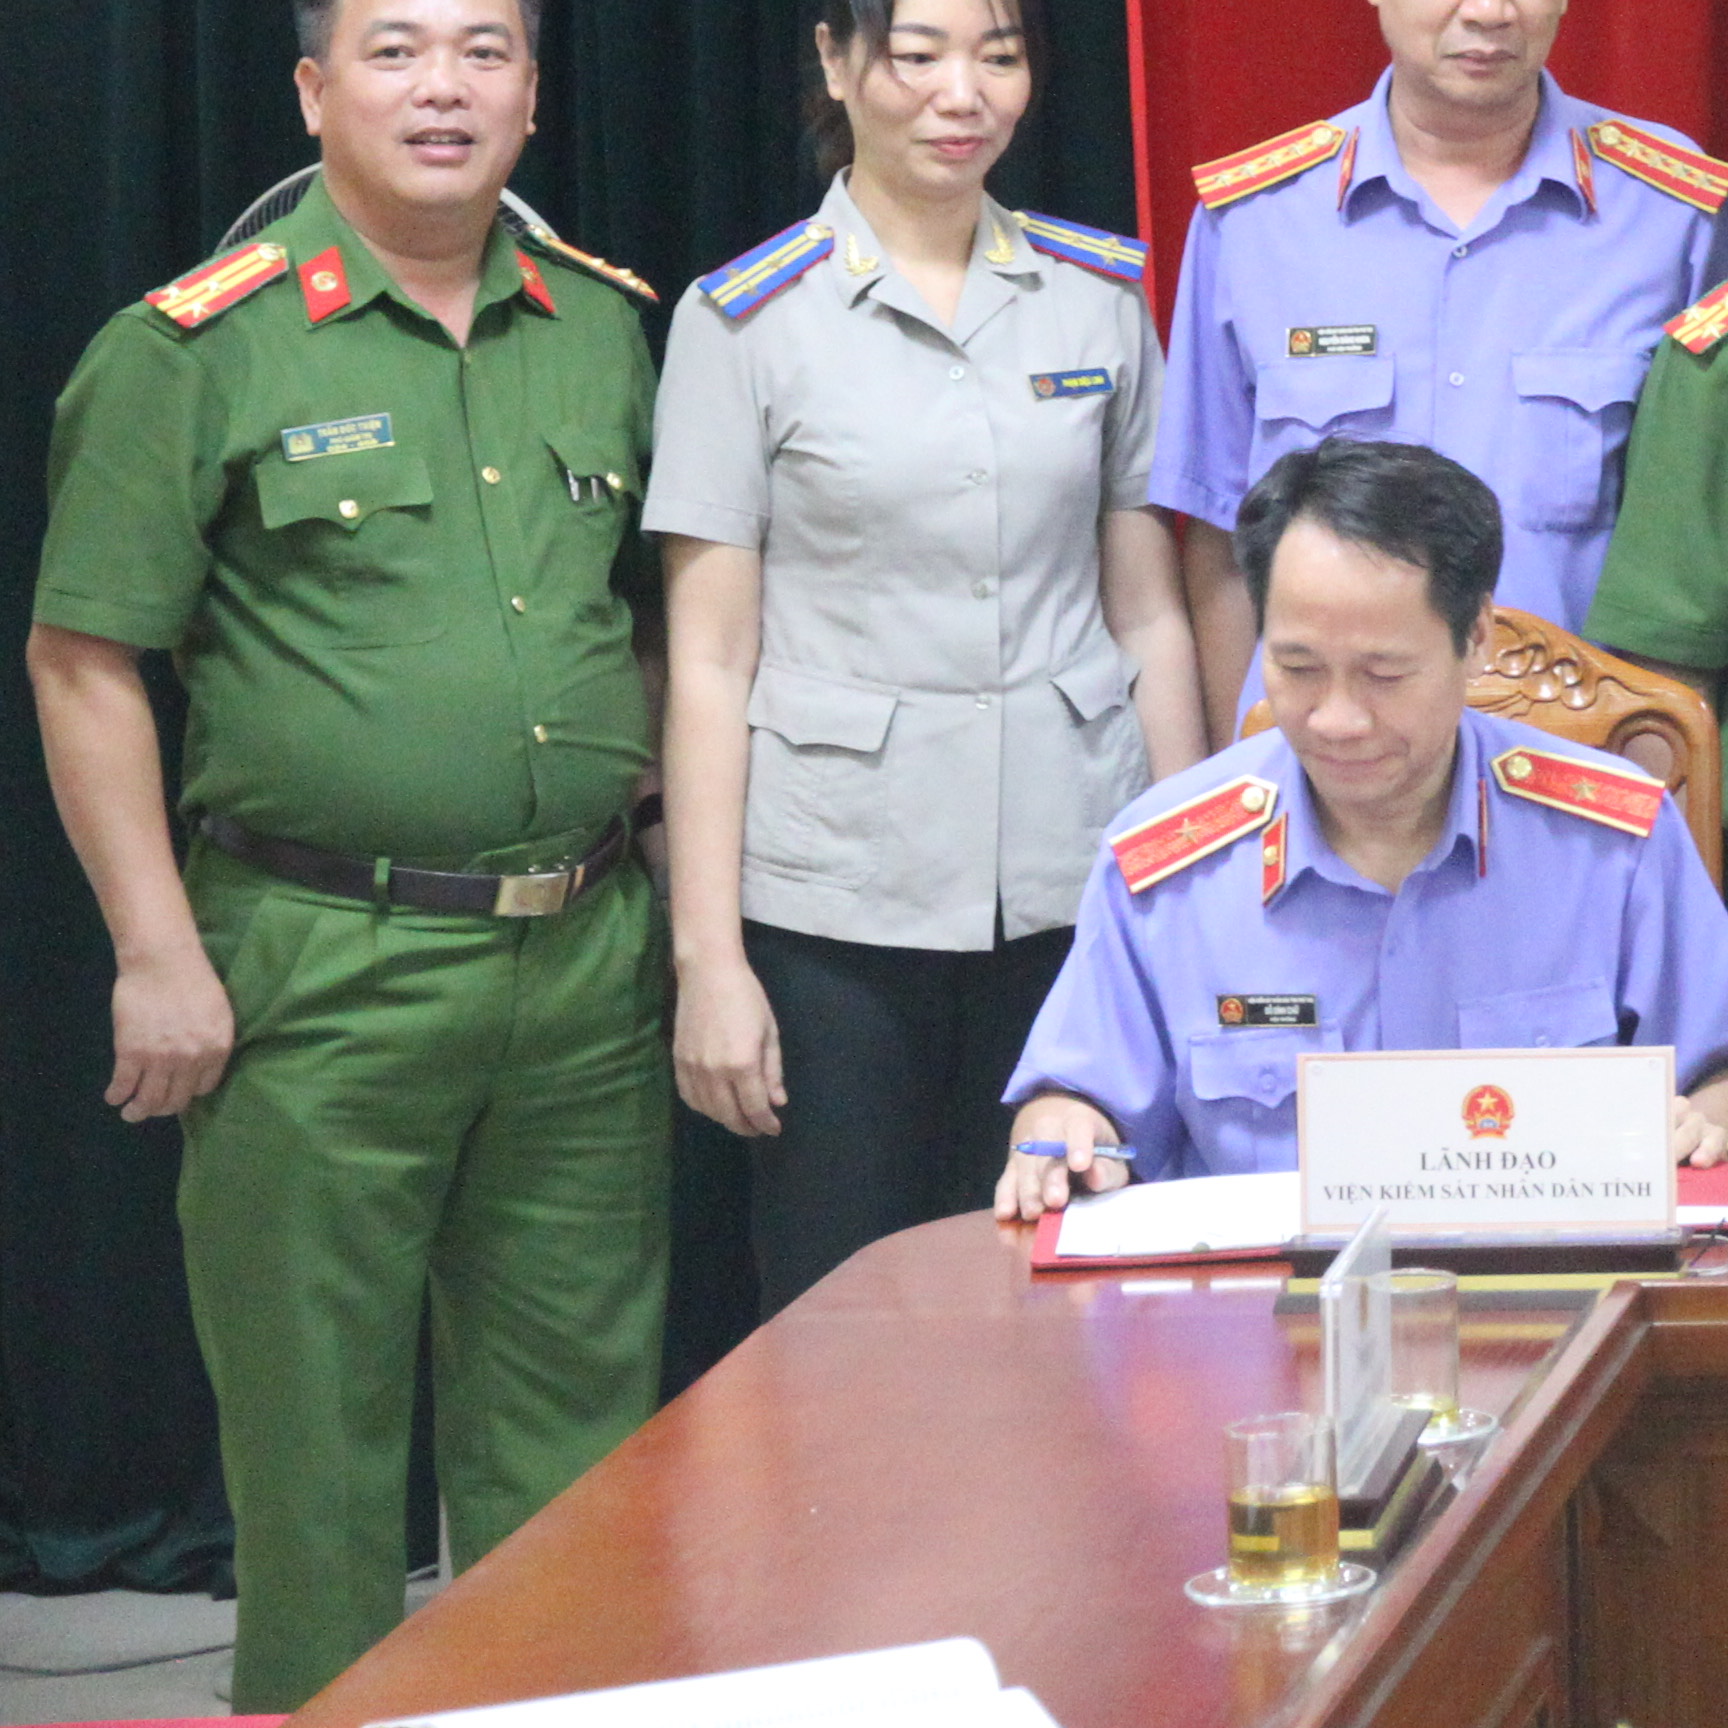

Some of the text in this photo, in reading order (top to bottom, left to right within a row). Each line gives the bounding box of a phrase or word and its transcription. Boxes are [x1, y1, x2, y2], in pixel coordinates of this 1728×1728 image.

[1419, 1148, 1556, 1174] LÃNH ĐẠO
[1323, 1184, 1372, 1204] VIỆN
[1441, 1181, 1480, 1199] SÁT
[1486, 1179, 1545, 1199] NHÂN
[1552, 1179, 1594, 1198] DÂN
